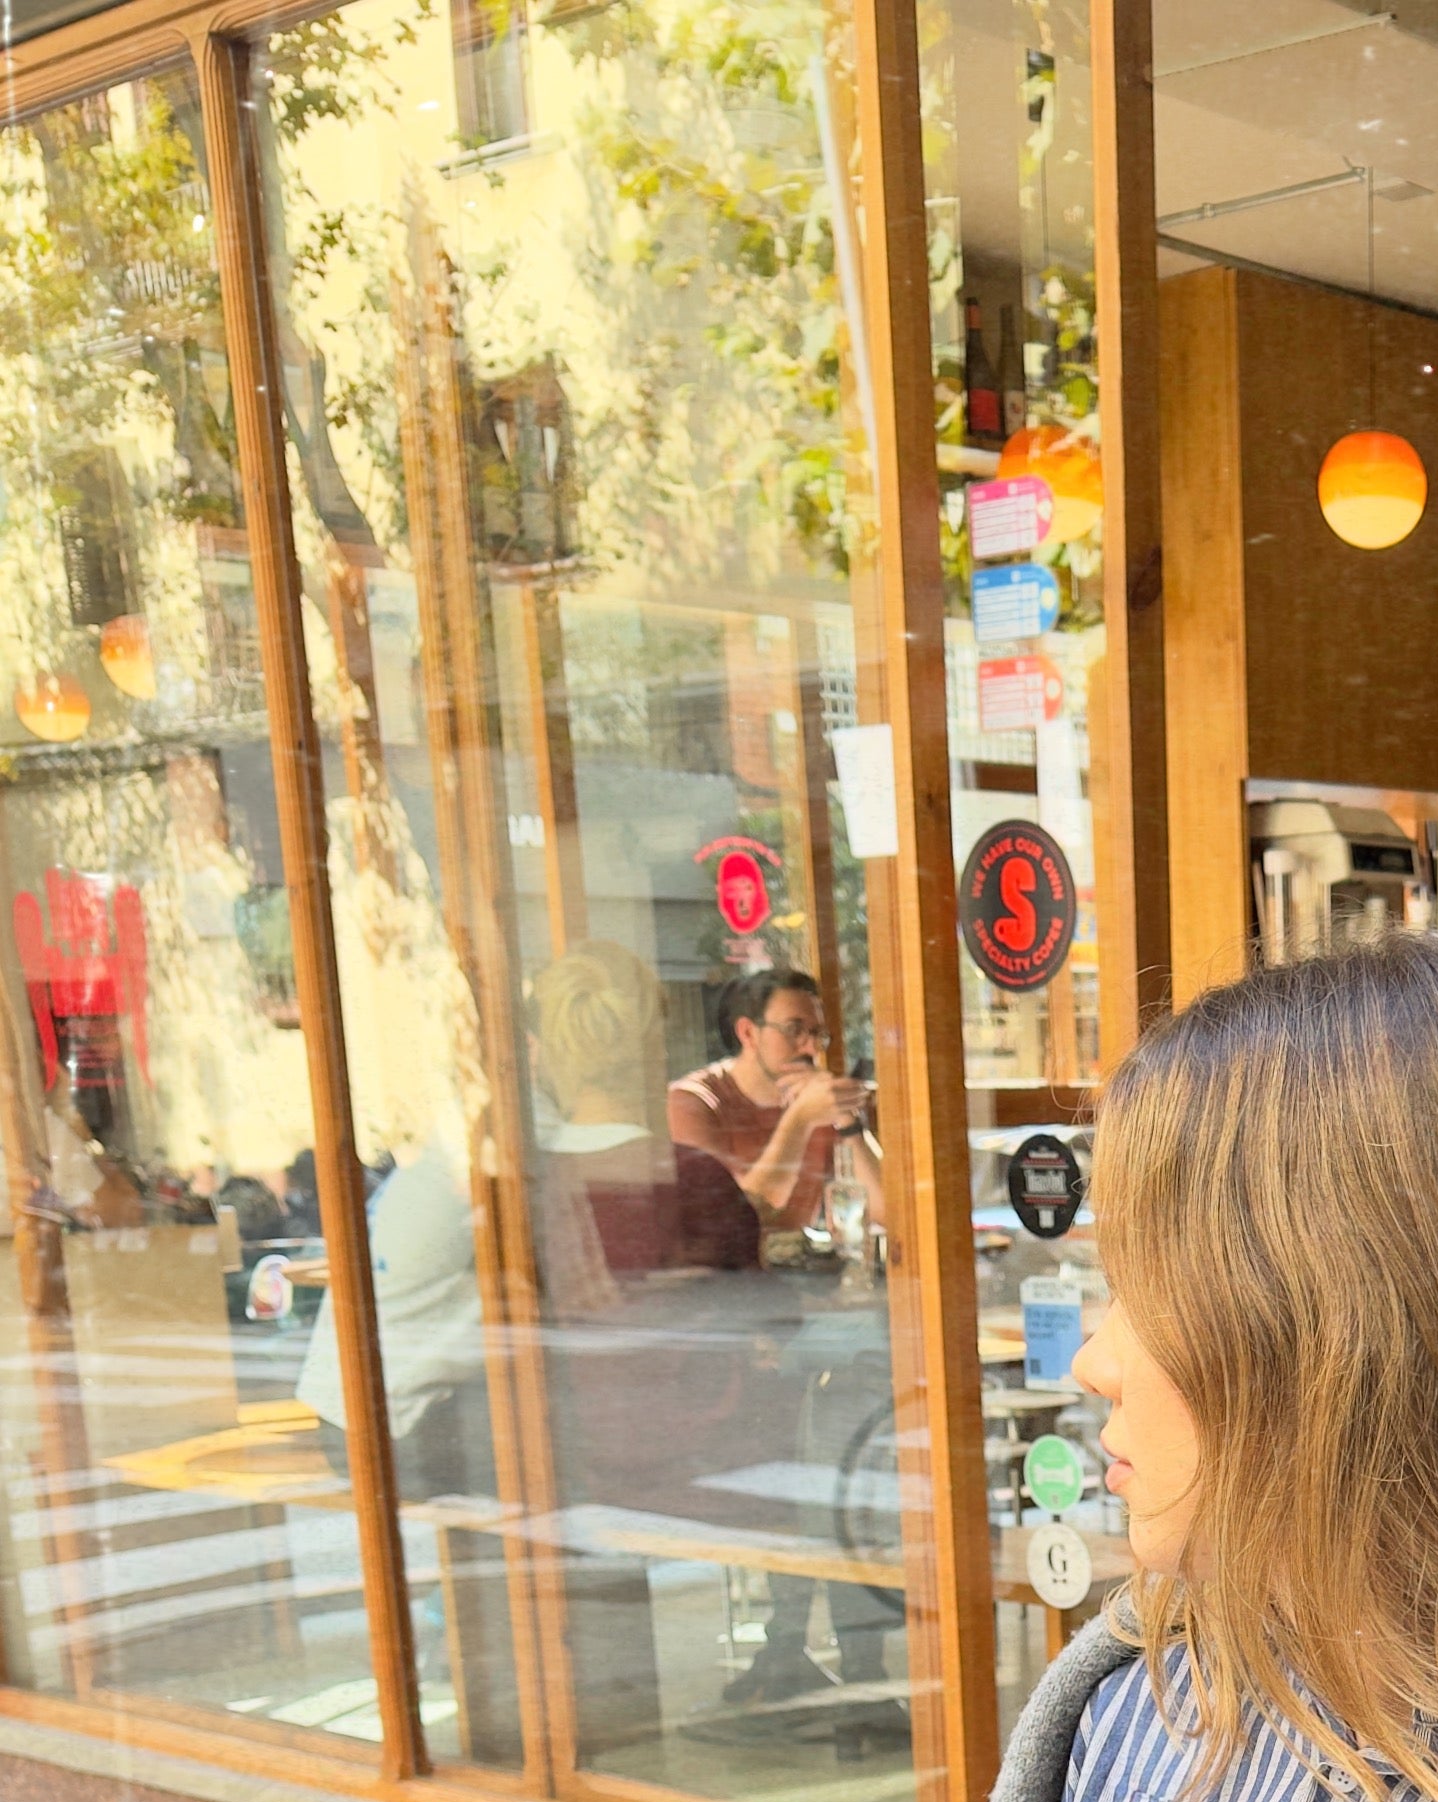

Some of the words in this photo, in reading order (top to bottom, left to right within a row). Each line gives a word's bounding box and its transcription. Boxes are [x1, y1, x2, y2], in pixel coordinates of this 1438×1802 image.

[981, 837, 1013, 870] HAVE
[1014, 836, 1043, 860] OUR
[1041, 856, 1064, 900] OWN
[972, 917, 1032, 972] SPECIALTY
[1031, 916, 1065, 966] COFFEE
[1048, 1543, 1067, 1575] G
